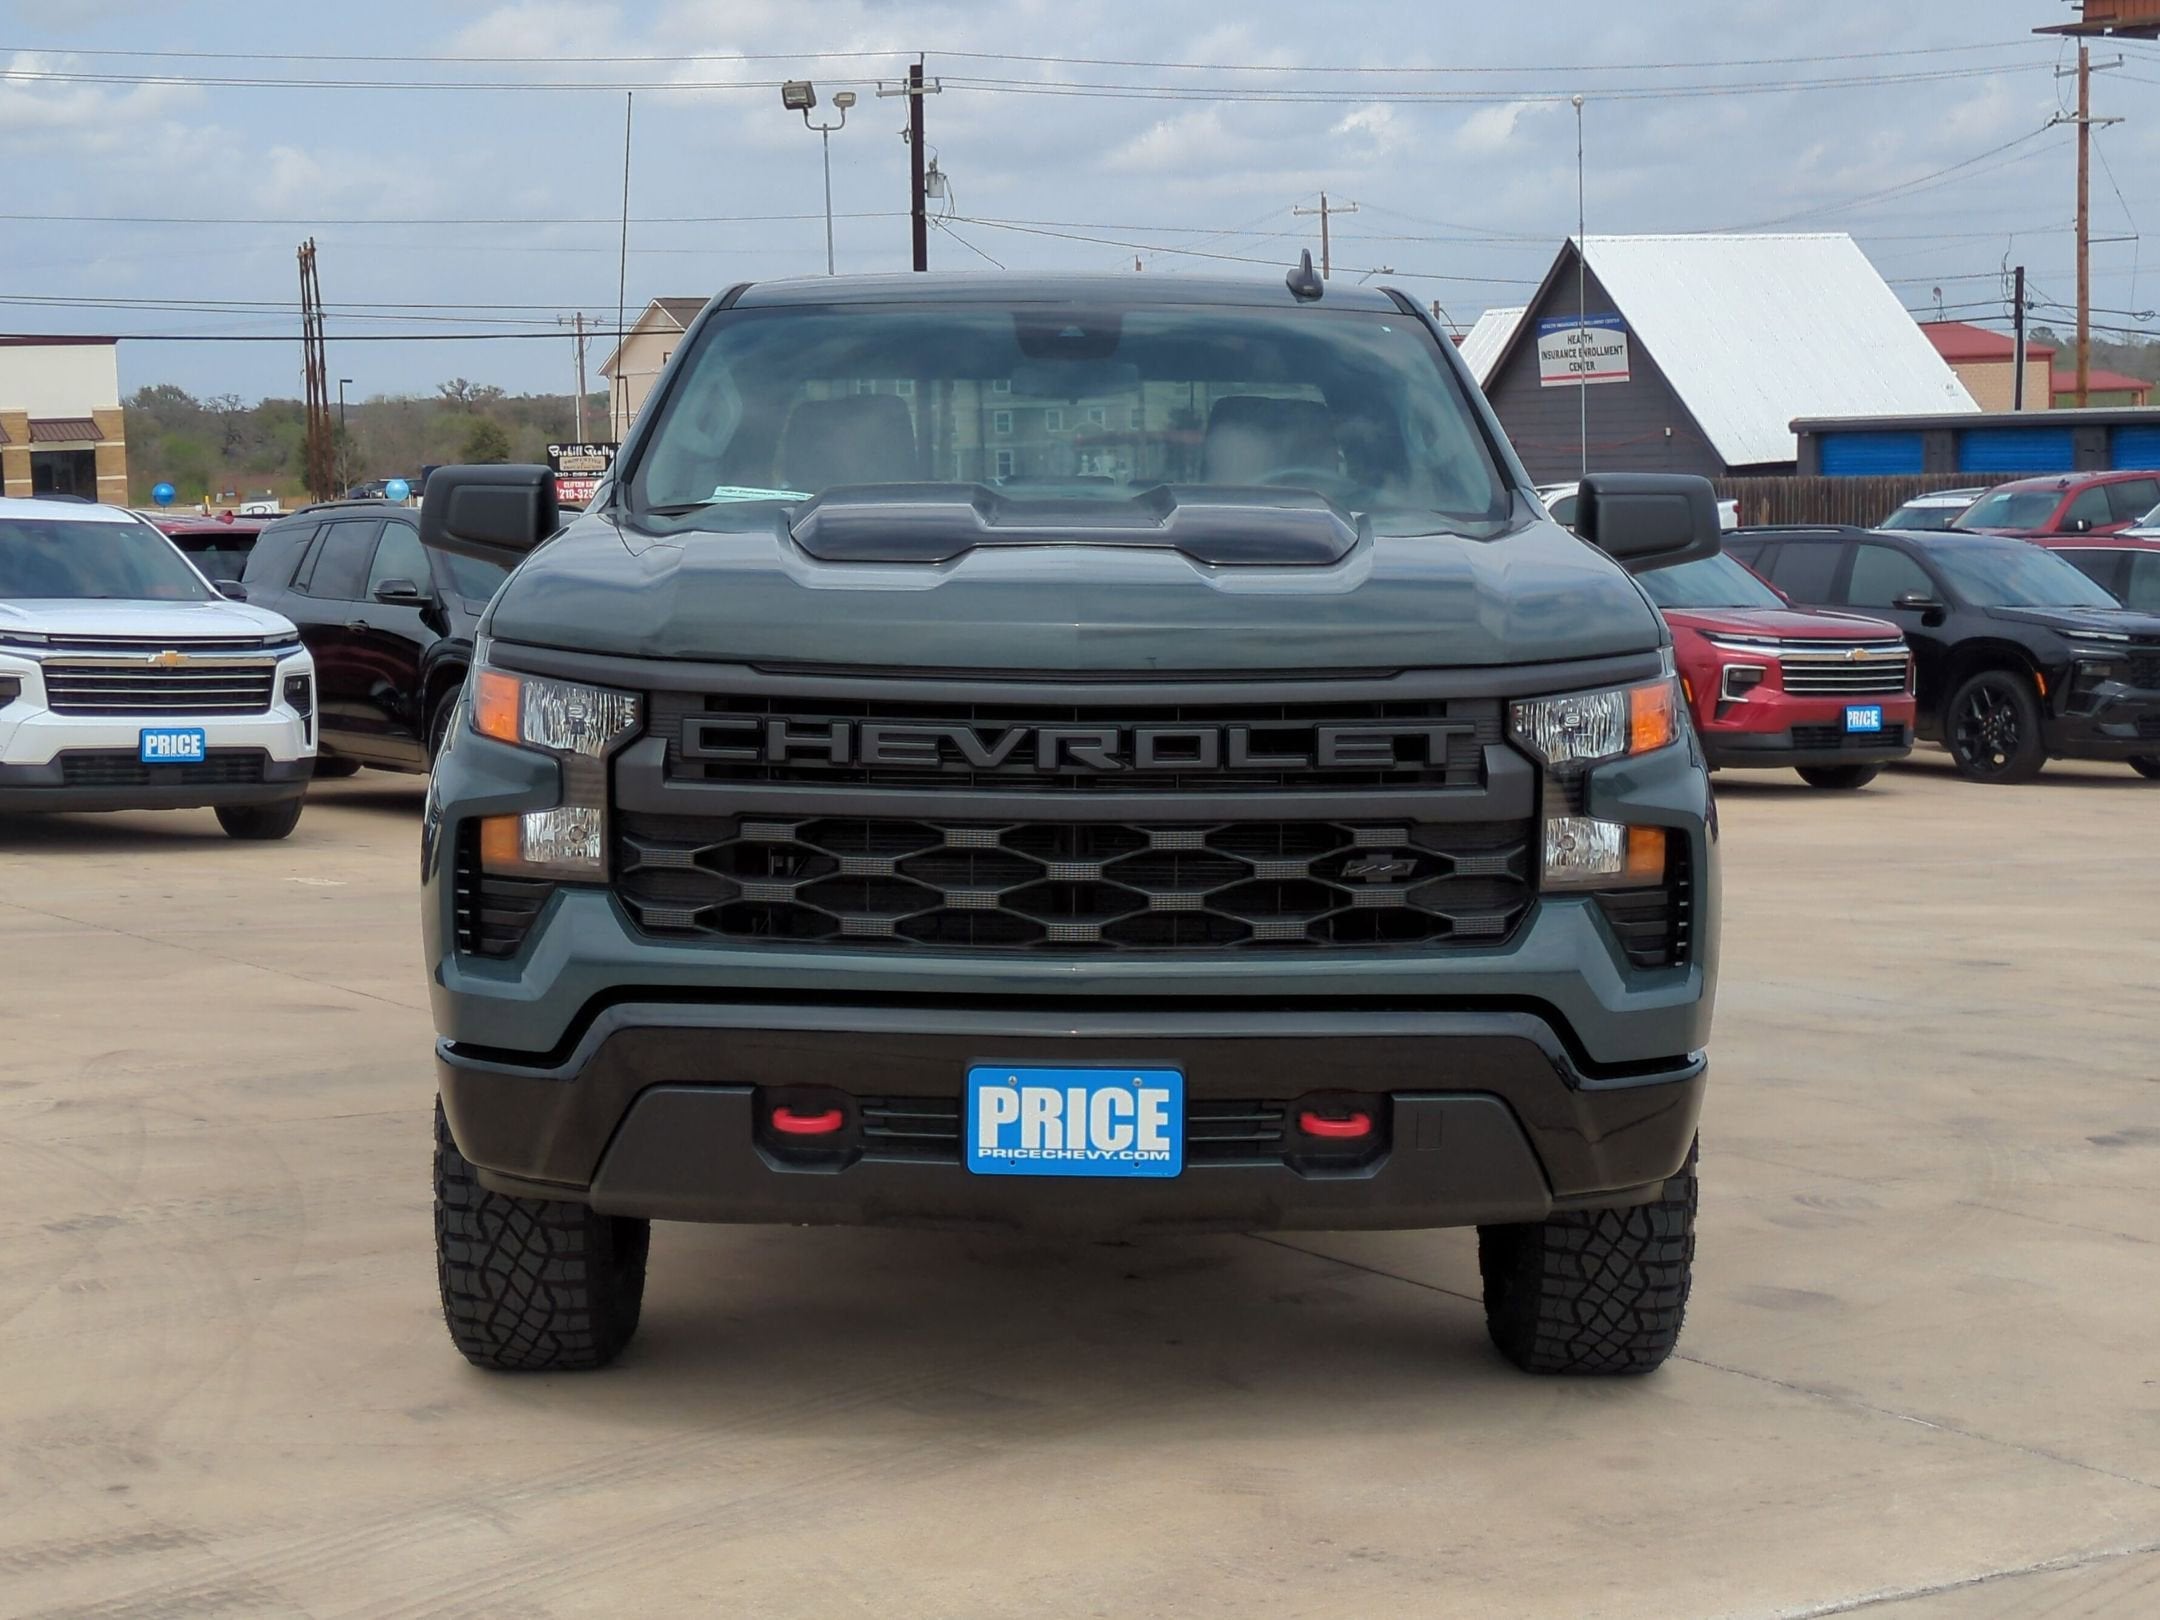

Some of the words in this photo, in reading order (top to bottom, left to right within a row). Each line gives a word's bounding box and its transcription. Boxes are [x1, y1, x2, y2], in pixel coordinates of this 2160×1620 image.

[1568, 333, 1593, 345] HEATH
[1541, 348, 1577, 360] INSURANCE
[1569, 361, 1596, 372] CENER
[1848, 710, 1878, 726] PRICE
[145, 734, 201, 754] PRICE
[682, 717, 1476, 770] CHEVROLET
[978, 1086, 1170, 1151] PRICE
[978, 1149, 1170, 1161] PRICECHEVY.COM
